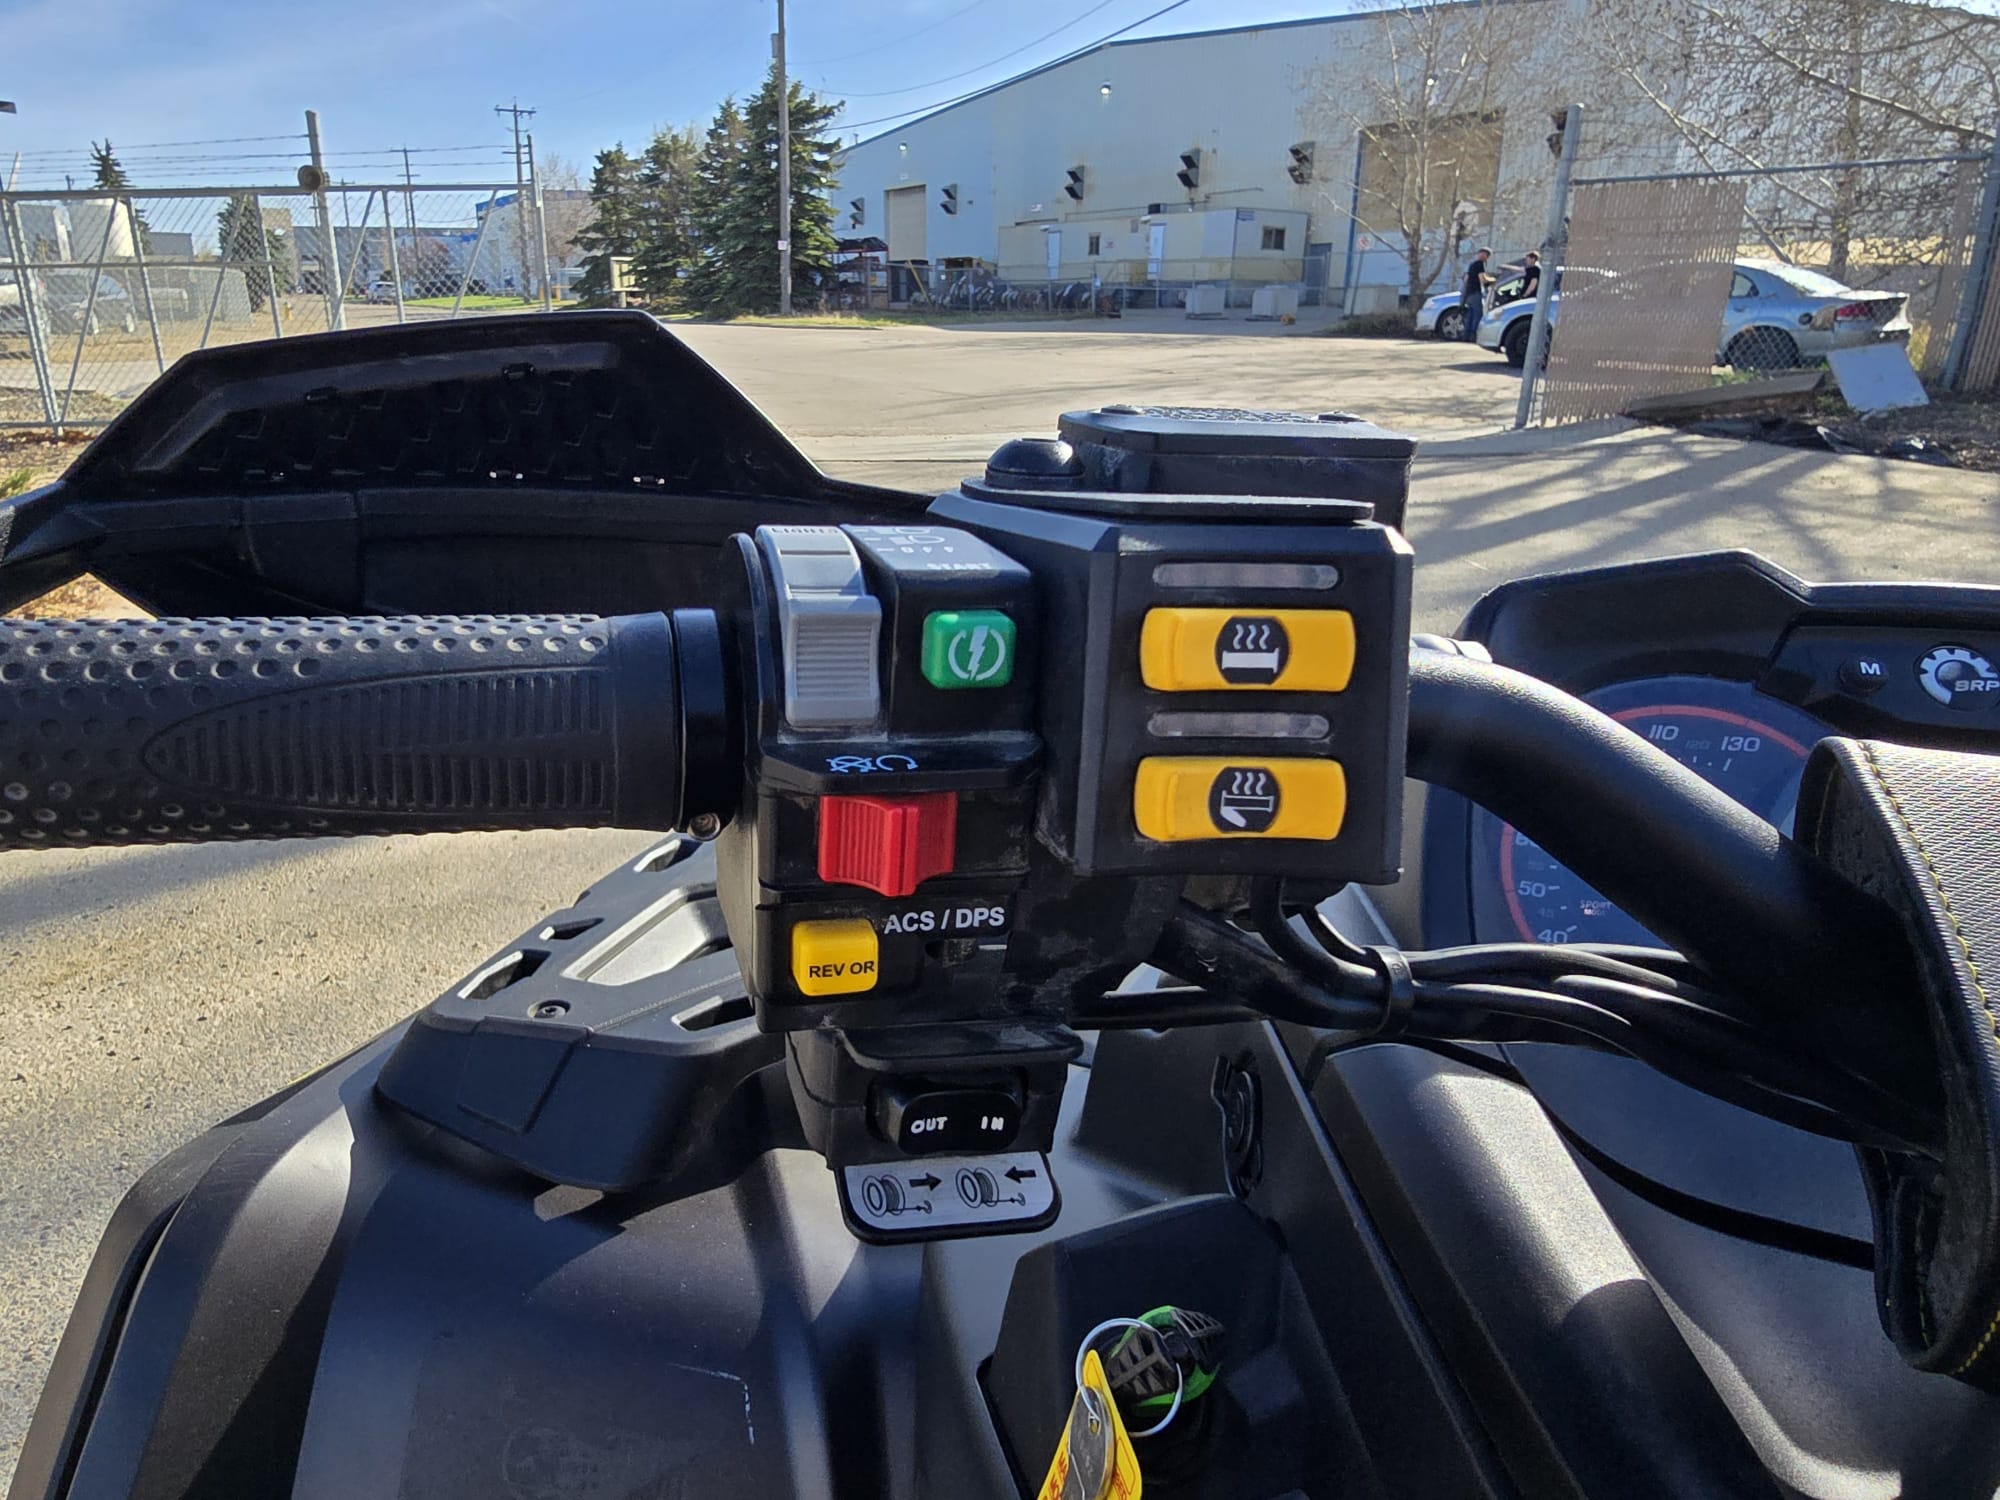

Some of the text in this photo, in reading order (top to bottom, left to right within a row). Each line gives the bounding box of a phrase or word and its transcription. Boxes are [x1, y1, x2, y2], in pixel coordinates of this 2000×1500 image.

[1859, 661, 1881, 675] M
[1648, 724, 1679, 741] 110
[1721, 736, 1761, 752] 130
[1517, 880, 1546, 898] 50
[883, 907, 1004, 934] ACS / DPS
[1537, 928, 1568, 943] 40
[809, 961, 874, 979] REV OR
[911, 1115, 1004, 1134] OUT IN
